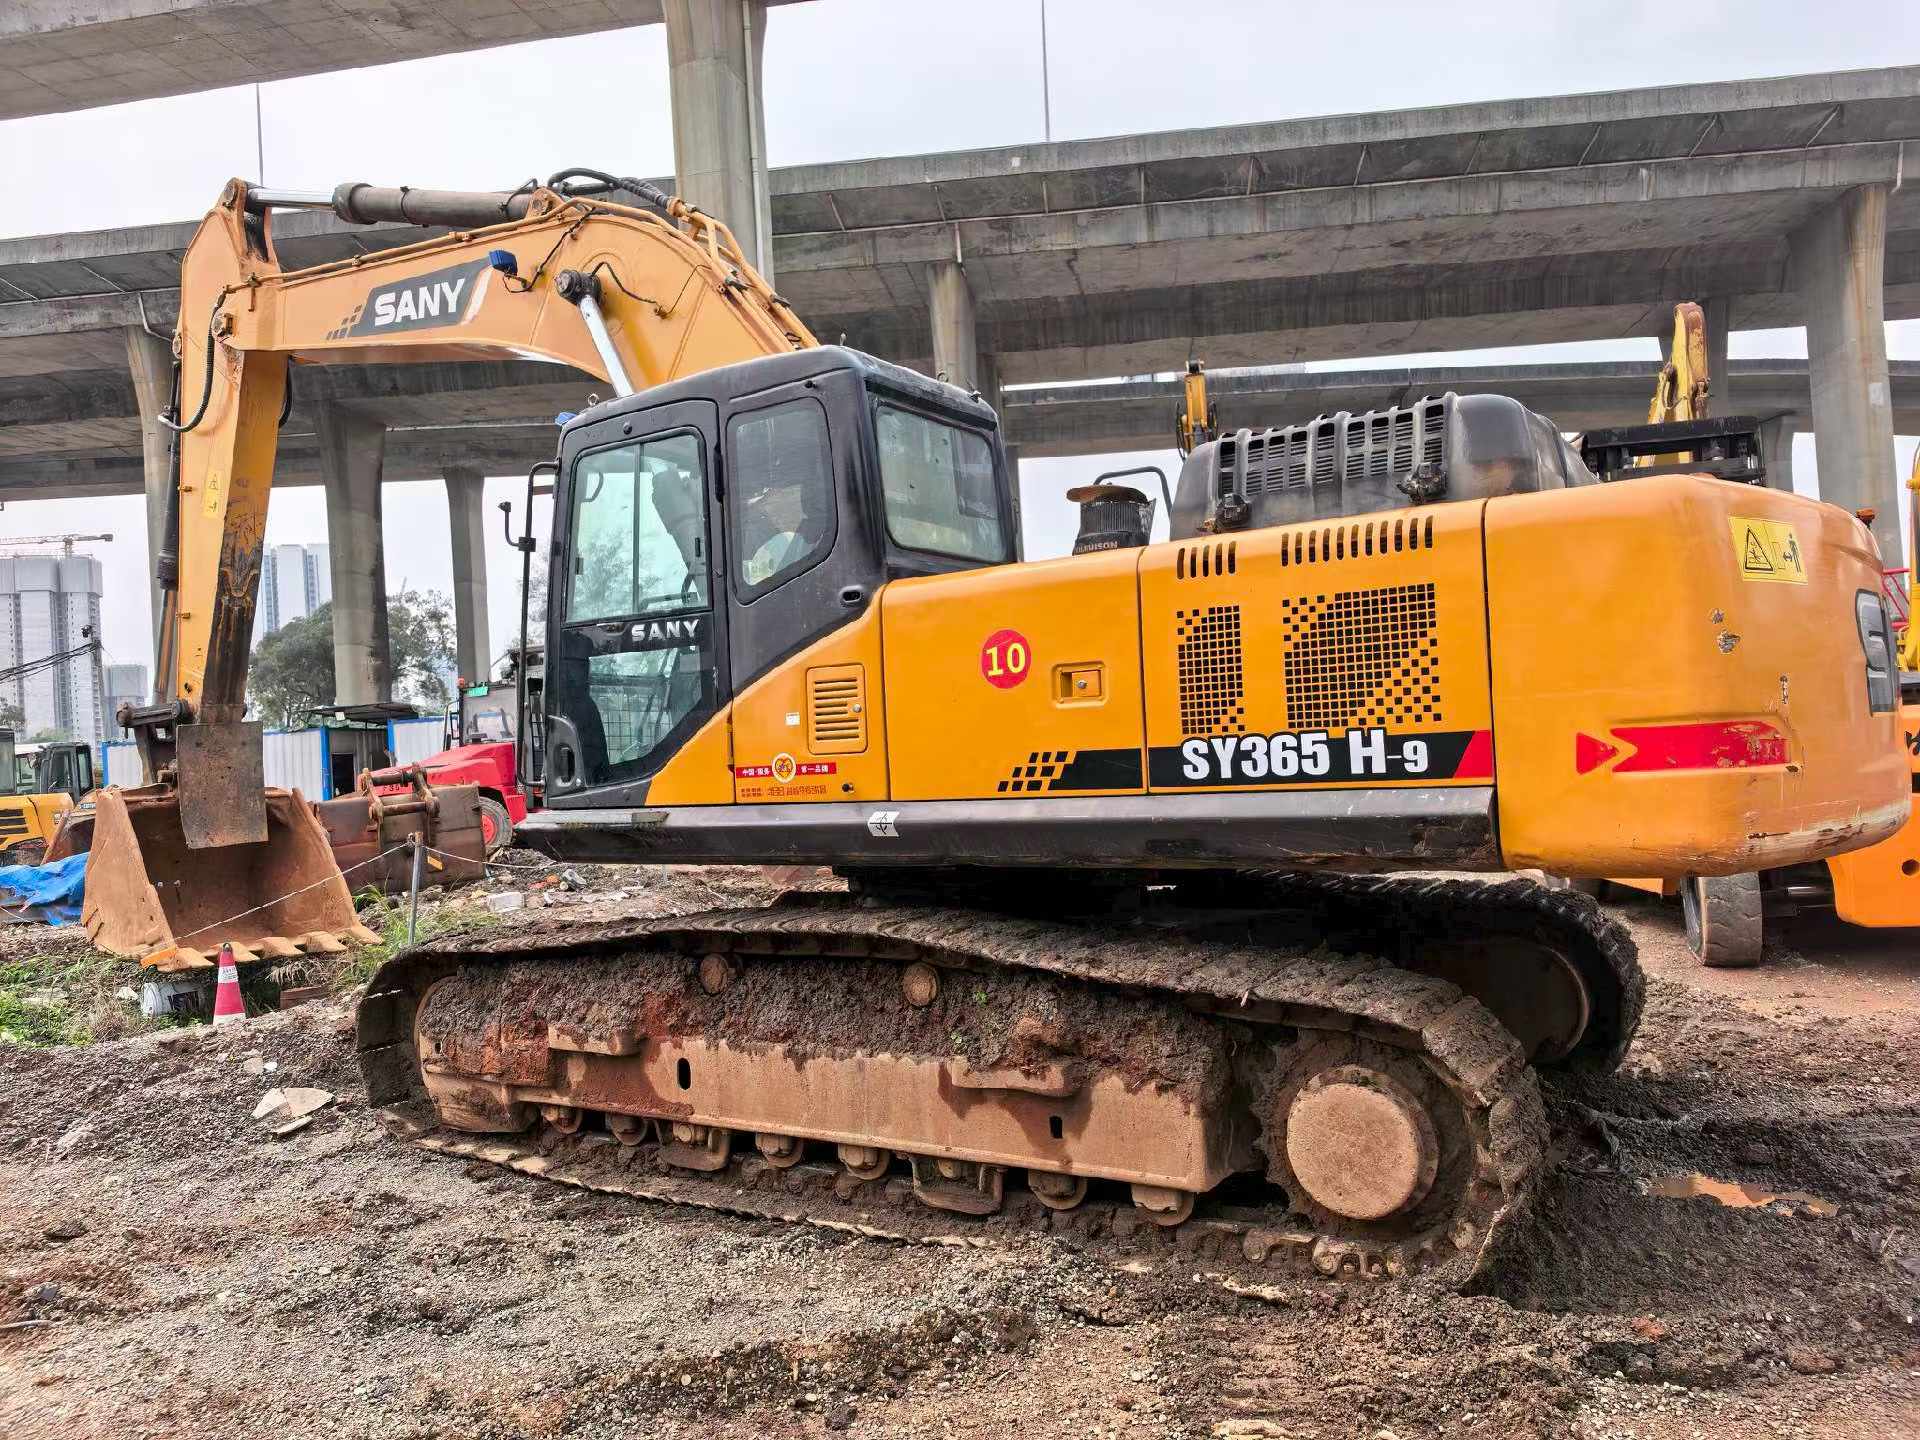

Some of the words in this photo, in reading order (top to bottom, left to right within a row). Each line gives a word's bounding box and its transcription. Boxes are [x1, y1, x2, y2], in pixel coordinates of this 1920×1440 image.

[374, 278, 465, 326] SANY
[631, 618, 699, 642] SANY
[985, 642, 1026, 677] 10
[1181, 730, 1330, 780] SY365
[1347, 728, 1429, 774] H-9
